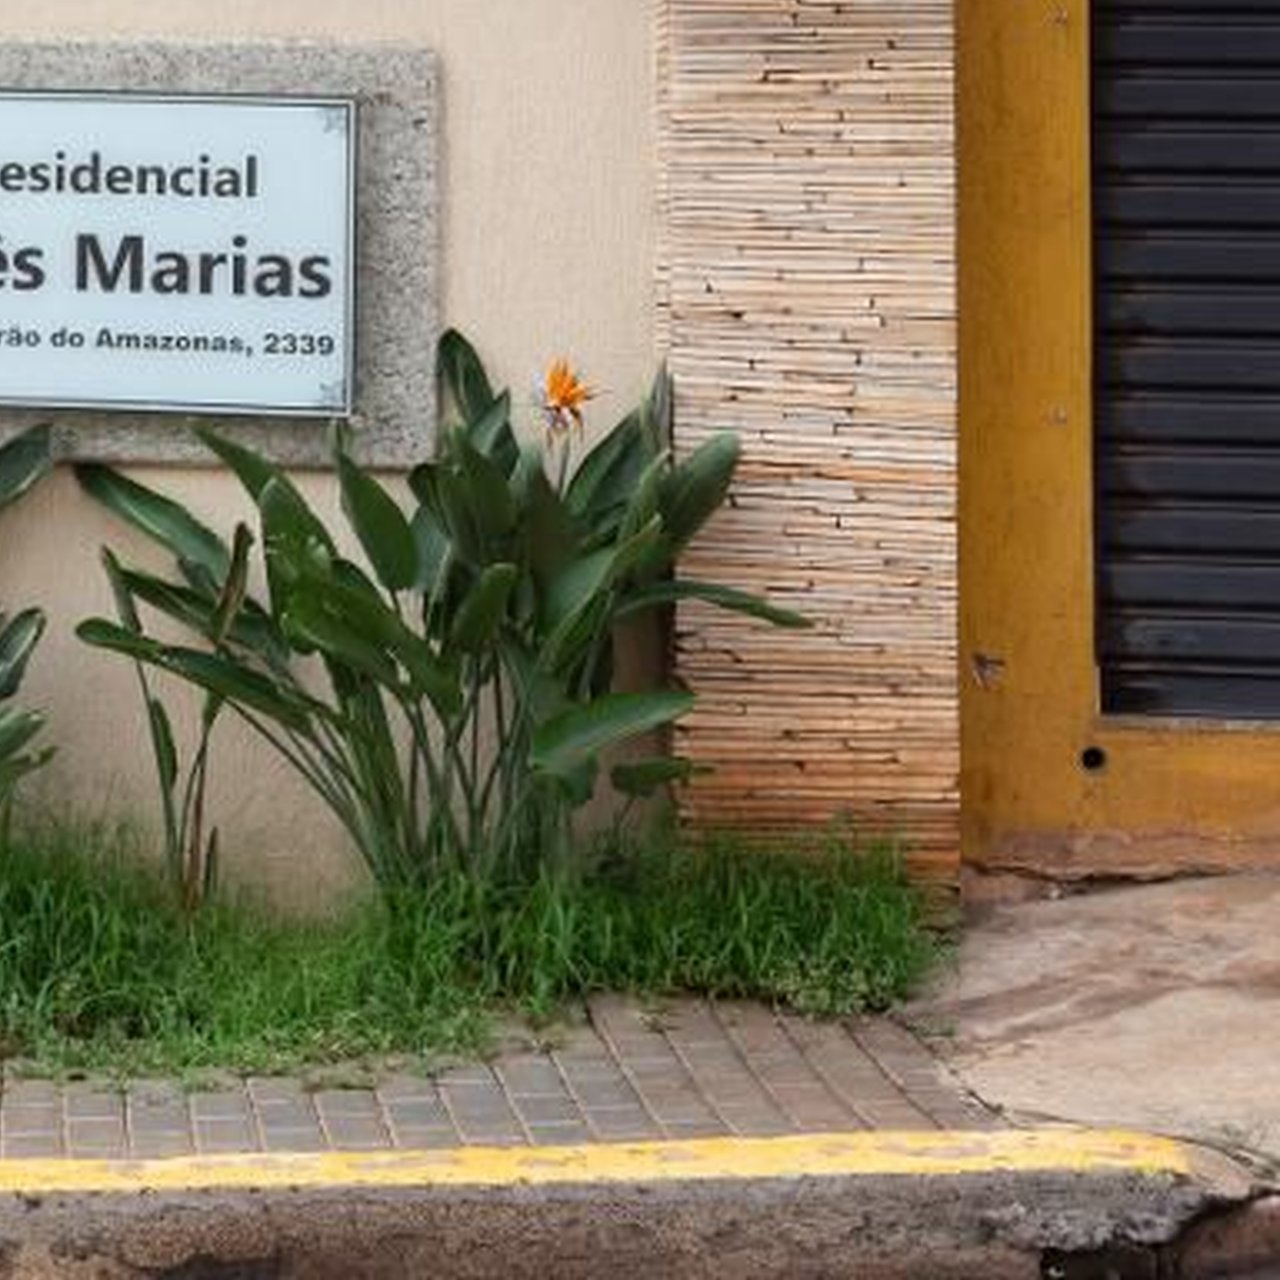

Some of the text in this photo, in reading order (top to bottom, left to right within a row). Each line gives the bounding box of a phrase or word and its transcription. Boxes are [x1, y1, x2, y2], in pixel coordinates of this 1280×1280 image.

[75, 233, 332, 300] Marias
[50, 327, 85, 348] do
[95, 328, 253, 357] Amazonas,
[263, 332, 335, 356] 2339
